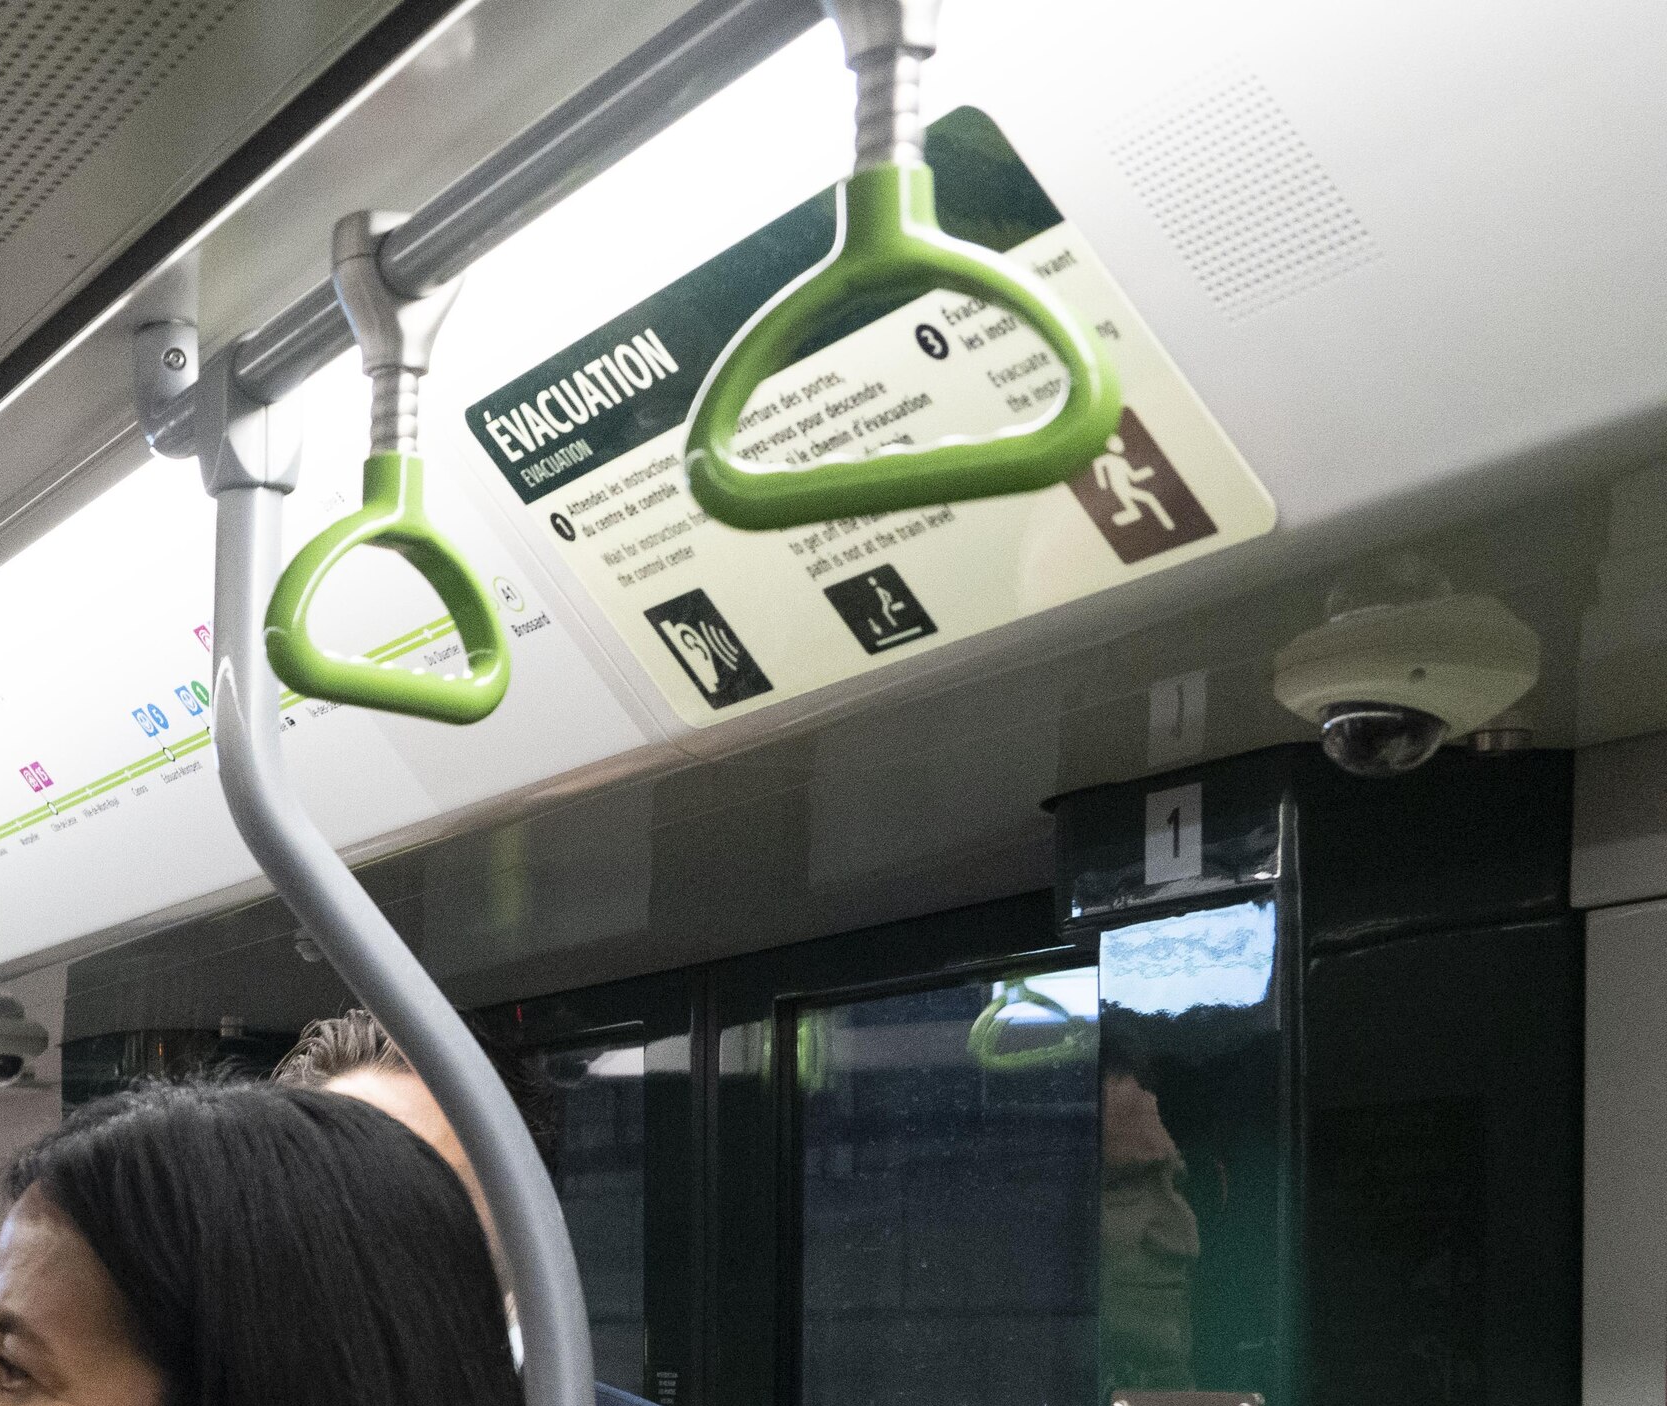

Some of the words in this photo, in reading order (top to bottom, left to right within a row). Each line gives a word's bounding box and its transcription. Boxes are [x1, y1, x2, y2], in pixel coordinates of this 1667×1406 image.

[483, 328, 679, 463] ÉVACUATION
[796, 411, 826, 438] pour
[824, 381, 888, 420] descendre
[519, 437, 594, 489] EVACUATION
[566, 489, 609, 518] Attendez
[501, 585, 518, 603] A1
[509, 610, 551, 638] Brossard
[1167, 806, 1180, 859] 1
